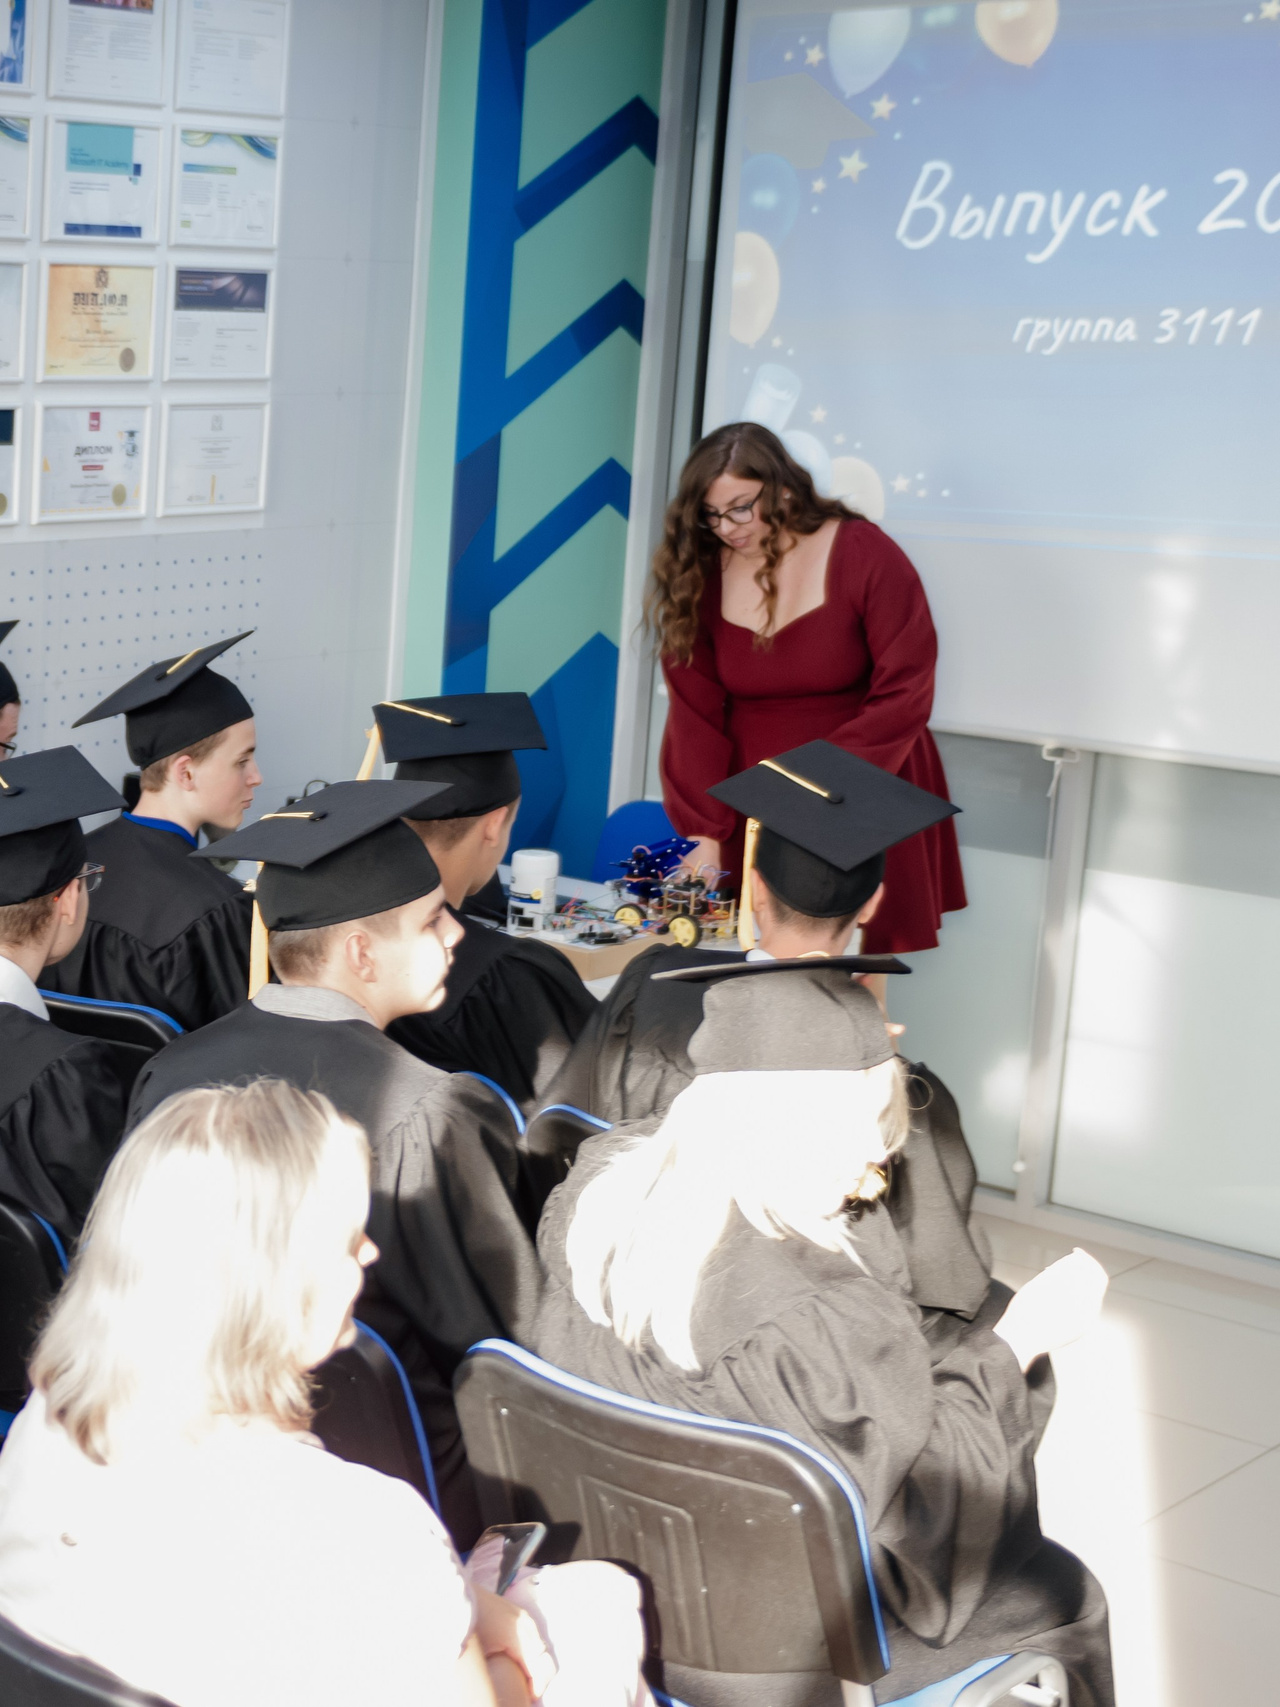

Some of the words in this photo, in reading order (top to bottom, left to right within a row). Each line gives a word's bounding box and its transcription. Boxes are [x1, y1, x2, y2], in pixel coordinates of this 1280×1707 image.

[895, 160, 1168, 265] Выпуск
[1012, 317, 1137, 356] группа
[1154, 307, 1262, 346] 3111
